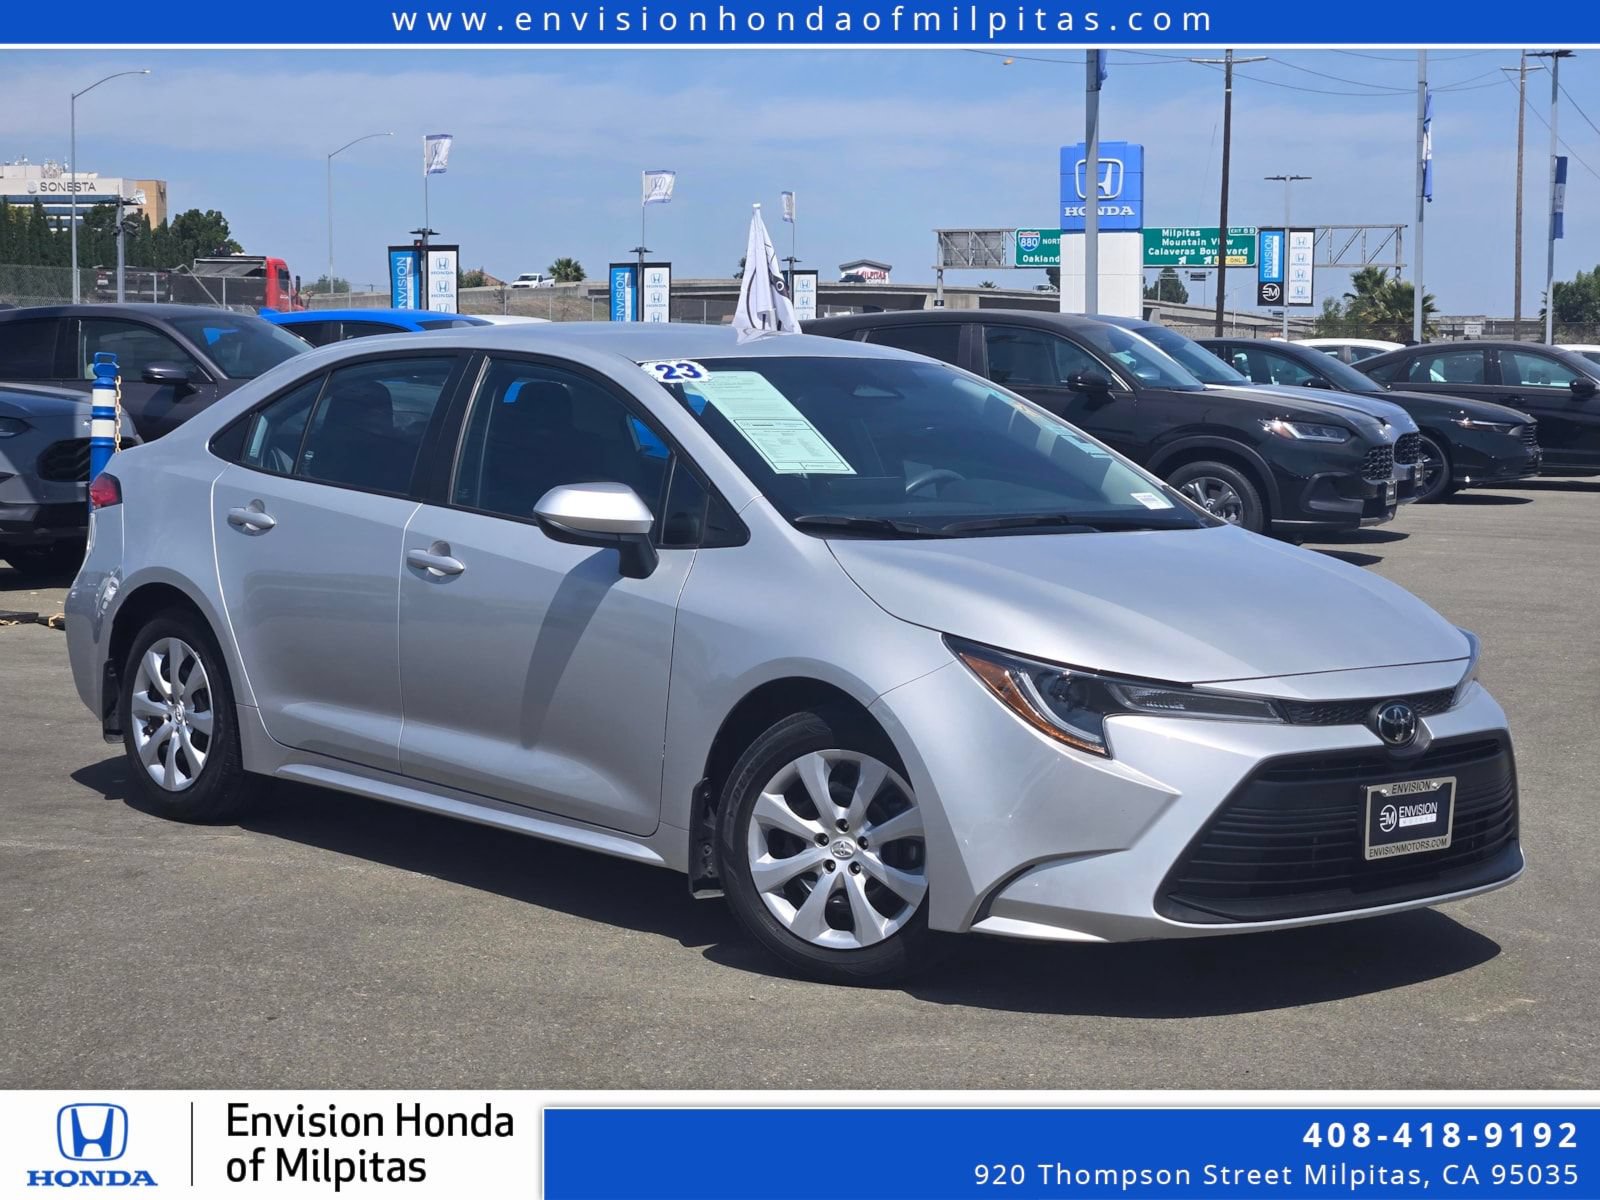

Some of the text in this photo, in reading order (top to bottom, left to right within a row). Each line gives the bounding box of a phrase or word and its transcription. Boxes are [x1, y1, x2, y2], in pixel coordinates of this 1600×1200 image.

[40, 182, 96, 192] SONESTA
[1162, 229, 1201, 238] Milpitas
[1021, 237, 1038, 247] 880
[1211, 237, 1234, 246] Viw
[1200, 247, 1248, 255] Bouvard
[1264, 235, 1273, 278] ENVISION
[1022, 255, 1060, 263] Oakland
[396, 256, 408, 309] NVISION
[655, 363, 702, 379] 23
[1392, 781, 1431, 794] ENVISION
[1399, 802, 1438, 818] ENVISION
[1369, 838, 1447, 858] ENVISIONMOTORS.COM
